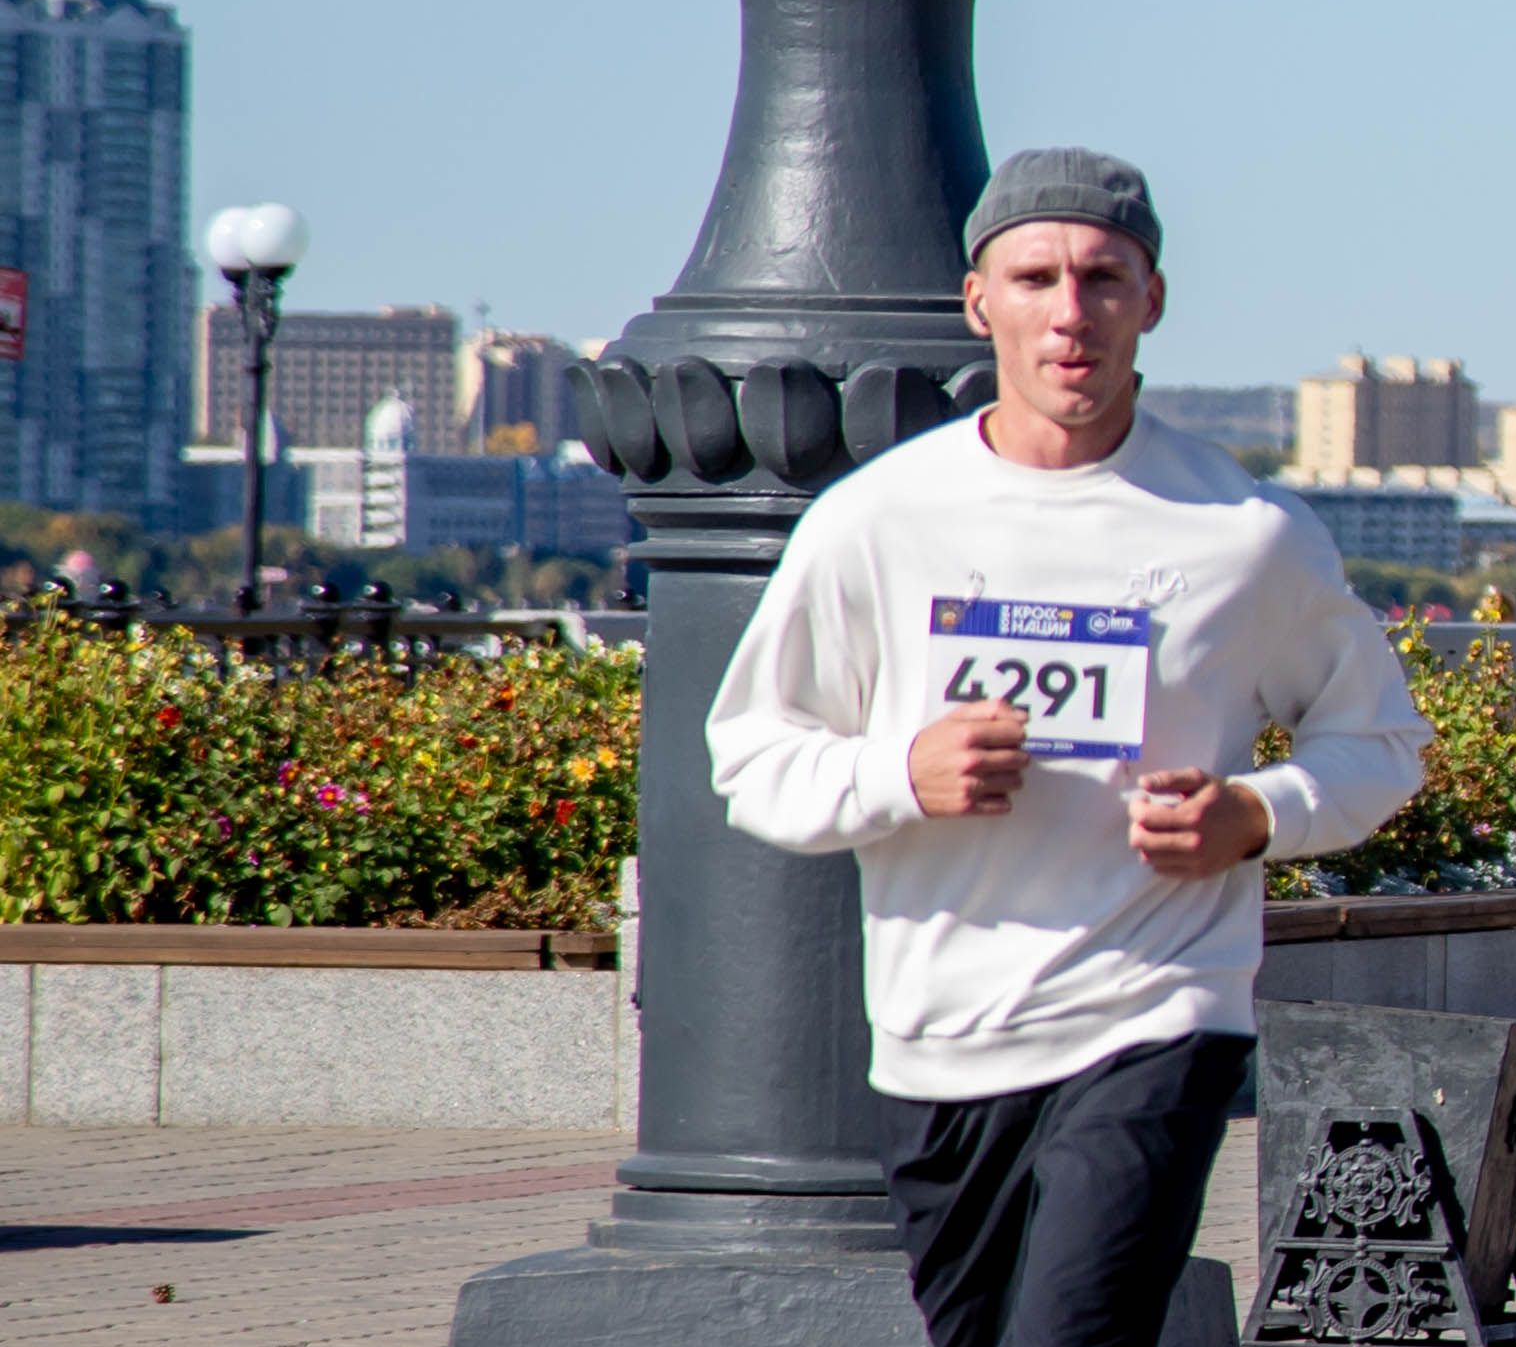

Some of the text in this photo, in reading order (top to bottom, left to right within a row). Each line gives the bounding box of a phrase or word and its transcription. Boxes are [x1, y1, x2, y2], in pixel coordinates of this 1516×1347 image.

[1013, 603, 1059, 621] КРОСС
[1012, 619, 1071, 638] НАЦИИ
[943, 655, 1110, 720] 4291
